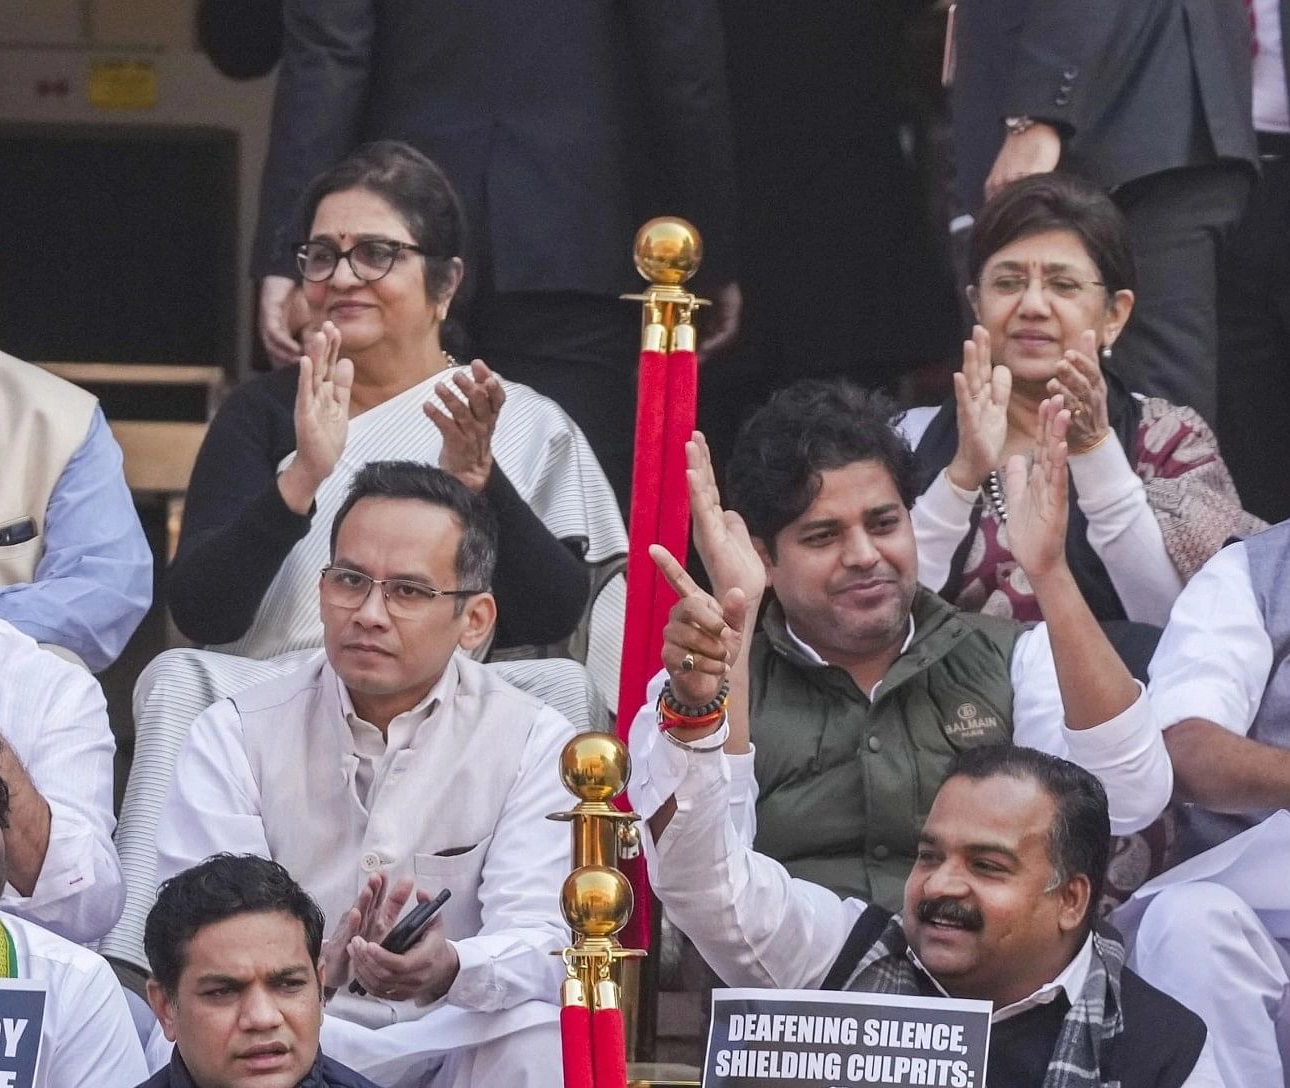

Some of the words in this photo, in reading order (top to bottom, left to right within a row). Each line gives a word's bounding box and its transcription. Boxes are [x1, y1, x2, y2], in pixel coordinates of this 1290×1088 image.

[944, 717, 997, 734] BALMAIN
[728, 1014, 858, 1045] DEAFENING
[862, 1021, 968, 1055] SILENCE,
[715, 1050, 842, 1081] SHIELDING
[846, 1054, 975, 1088] CULPRITS:
